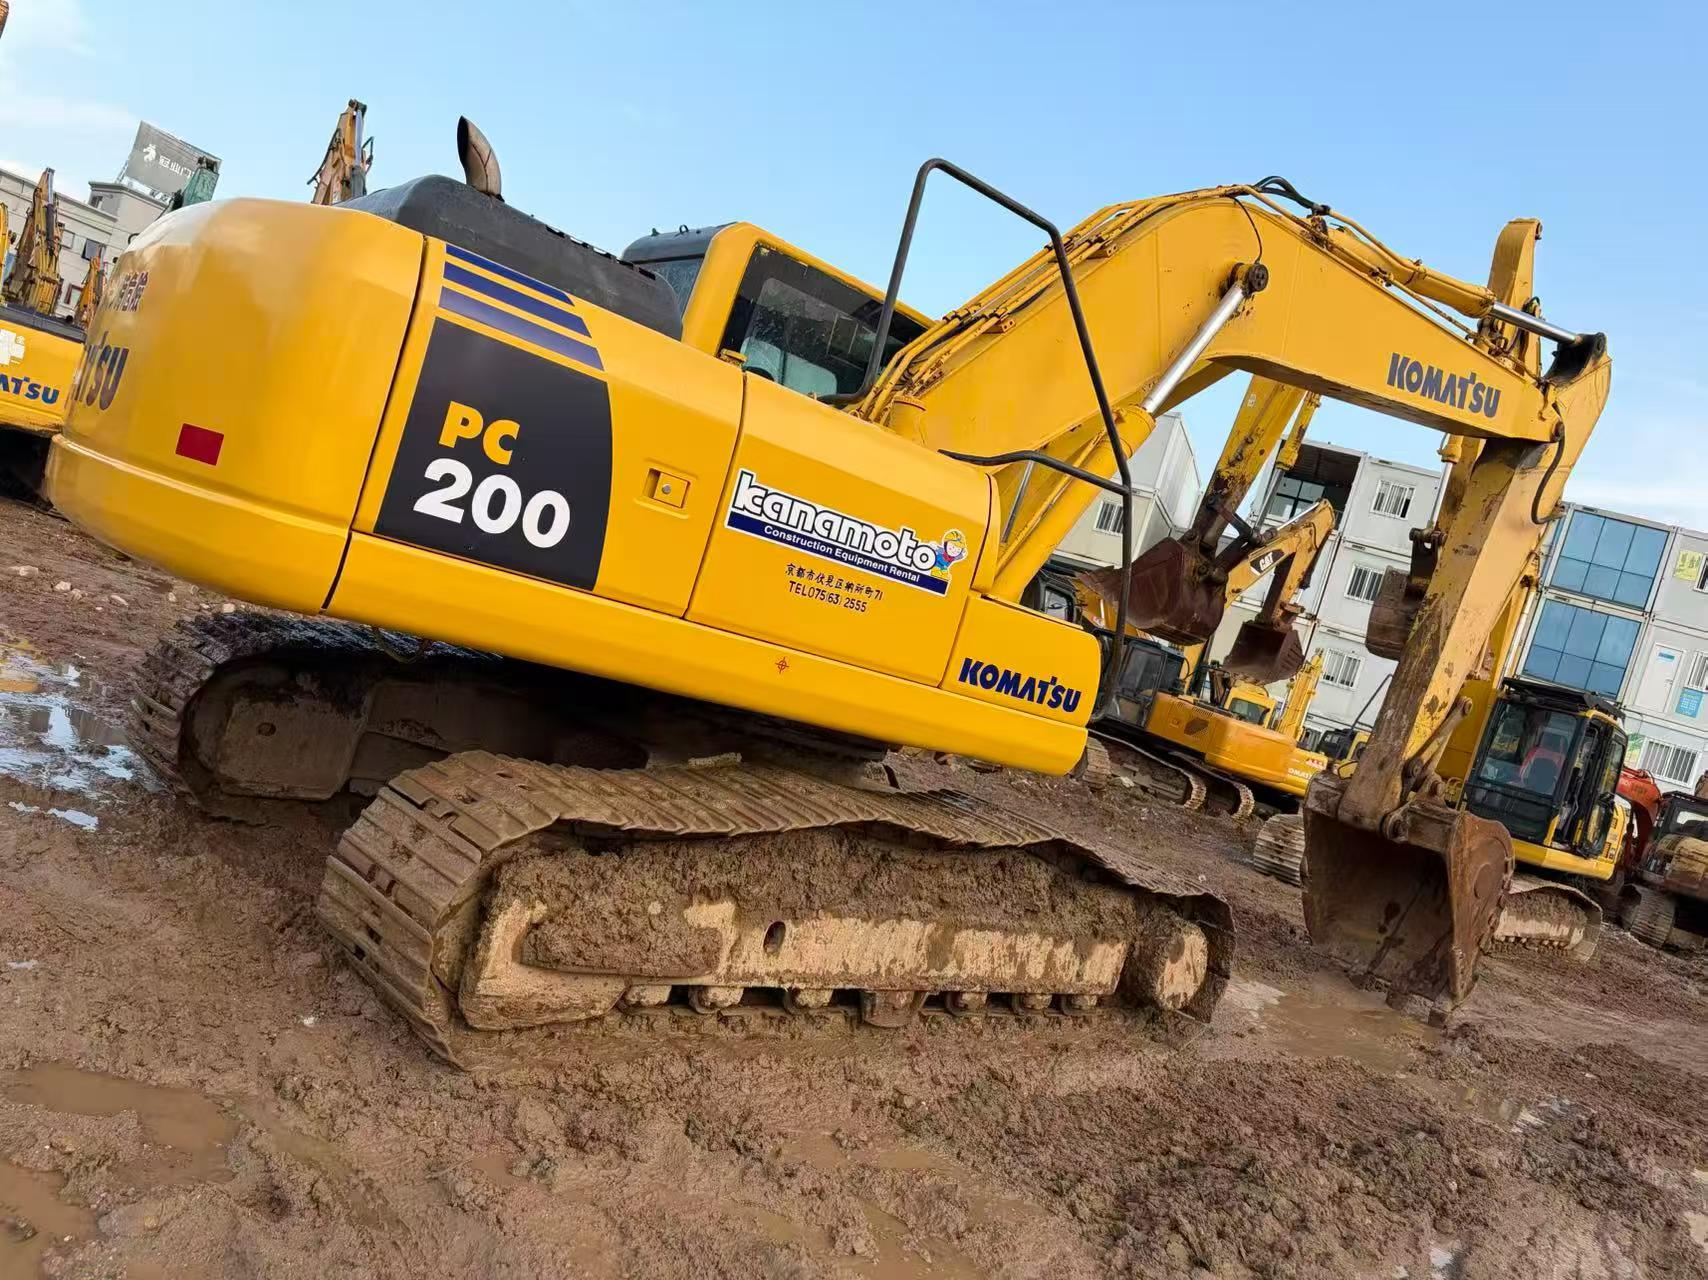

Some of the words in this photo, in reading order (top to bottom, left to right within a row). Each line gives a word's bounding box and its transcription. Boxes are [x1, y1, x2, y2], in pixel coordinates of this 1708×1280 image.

[1386, 352, 1501, 418] KOMATSU
[438, 401, 521, 465] PC
[413, 458, 571, 549] 200
[732, 470, 937, 571] kanamoto
[764, 525, 833, 555] Construction
[834, 547, 889, 572] Equipment
[889, 564, 920, 583] Rental
[1259, 551, 1274, 571] CAT
[958, 657, 1082, 713] KOMATSU
